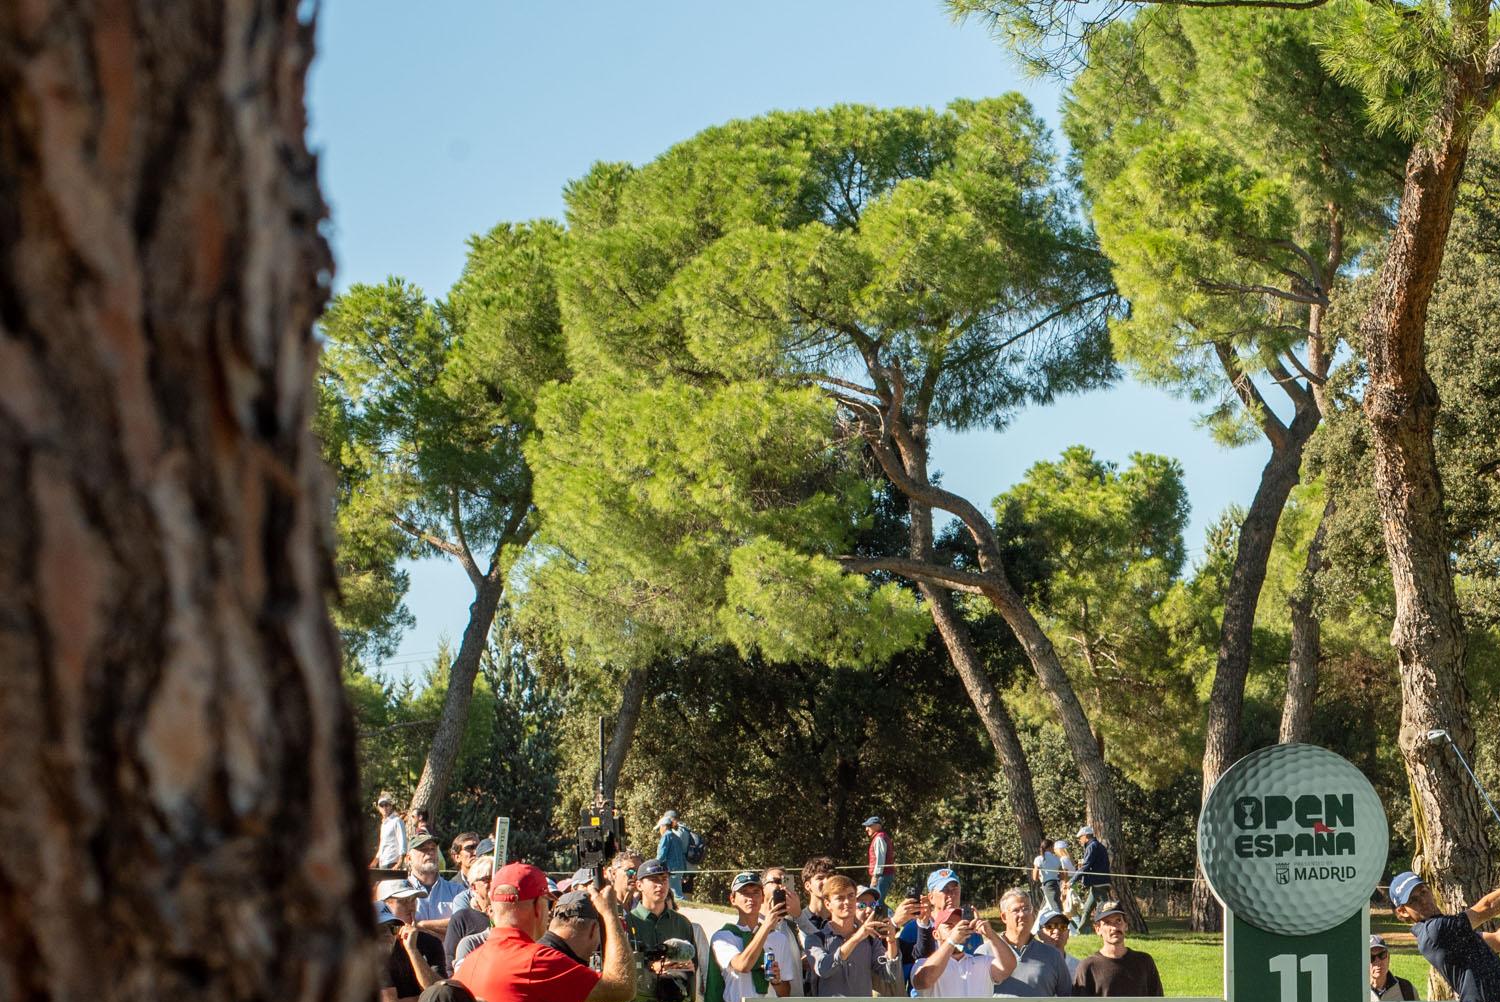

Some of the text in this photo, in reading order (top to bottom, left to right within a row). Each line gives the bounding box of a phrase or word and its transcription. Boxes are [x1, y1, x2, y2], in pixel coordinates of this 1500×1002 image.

[1233, 793, 1355, 830] OPEN
[1234, 825, 1356, 858] ESPAÑA
[1294, 866, 1356, 882] MADRID
